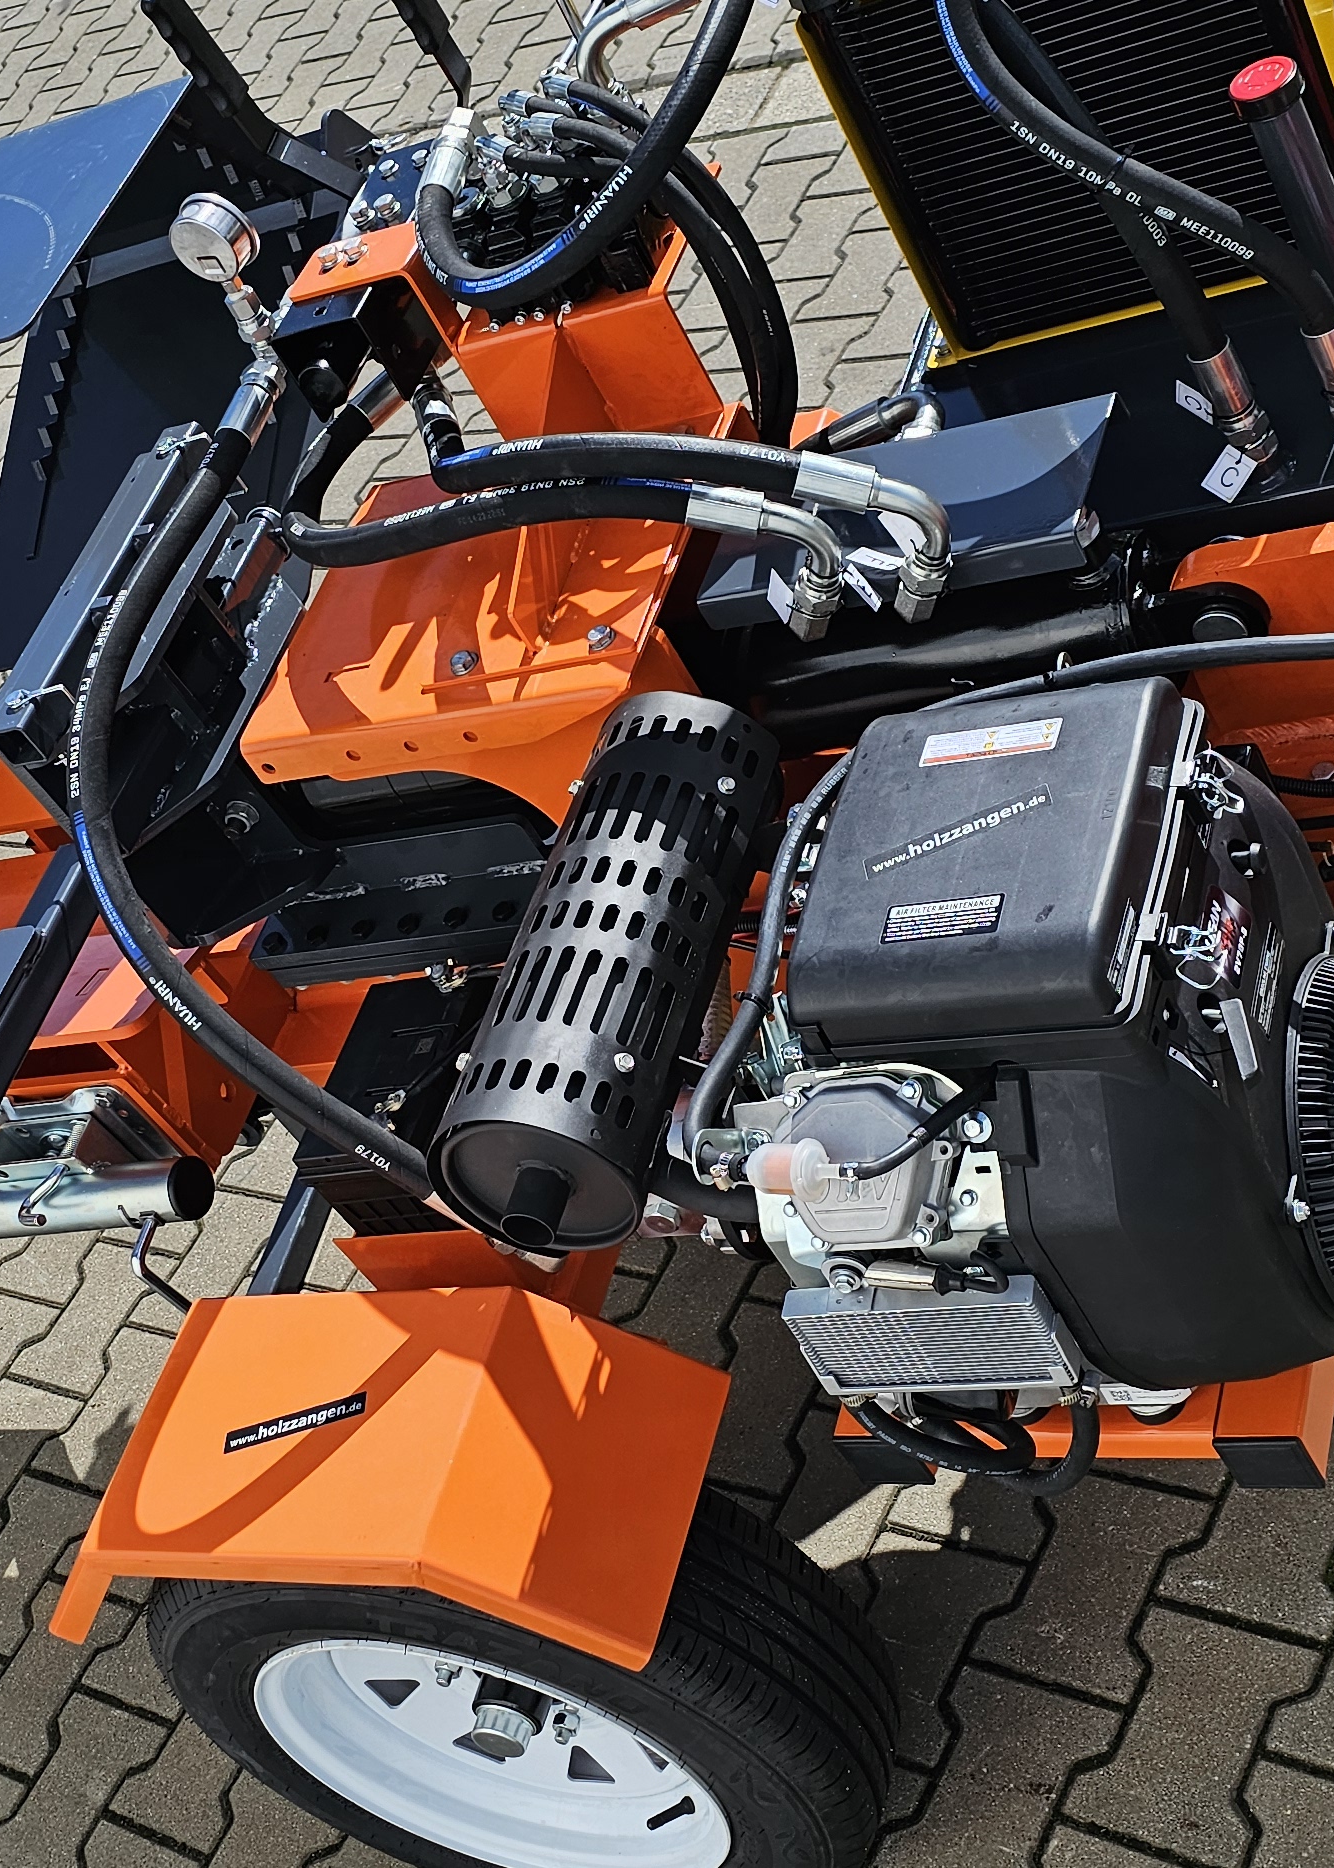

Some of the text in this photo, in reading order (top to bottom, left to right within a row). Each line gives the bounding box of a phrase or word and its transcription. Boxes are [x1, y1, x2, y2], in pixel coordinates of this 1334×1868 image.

[1009, 120, 1036, 145] 1SN
[1038, 143, 1075, 171] DN19
[1180, 217, 1255, 261] MEE110099
[1139, 213, 1167, 247] 0003
[1220, 466, 1239, 487] C
[820, 766, 848, 796] RUBBER
[871, 794, 1046, 874] www.holzzangen.de
[937, 898, 995, 912] MAINTENANCE
[354, 1144, 391, 1172] Y0179
[229, 1401, 362, 1448] www.holzzangen.de
